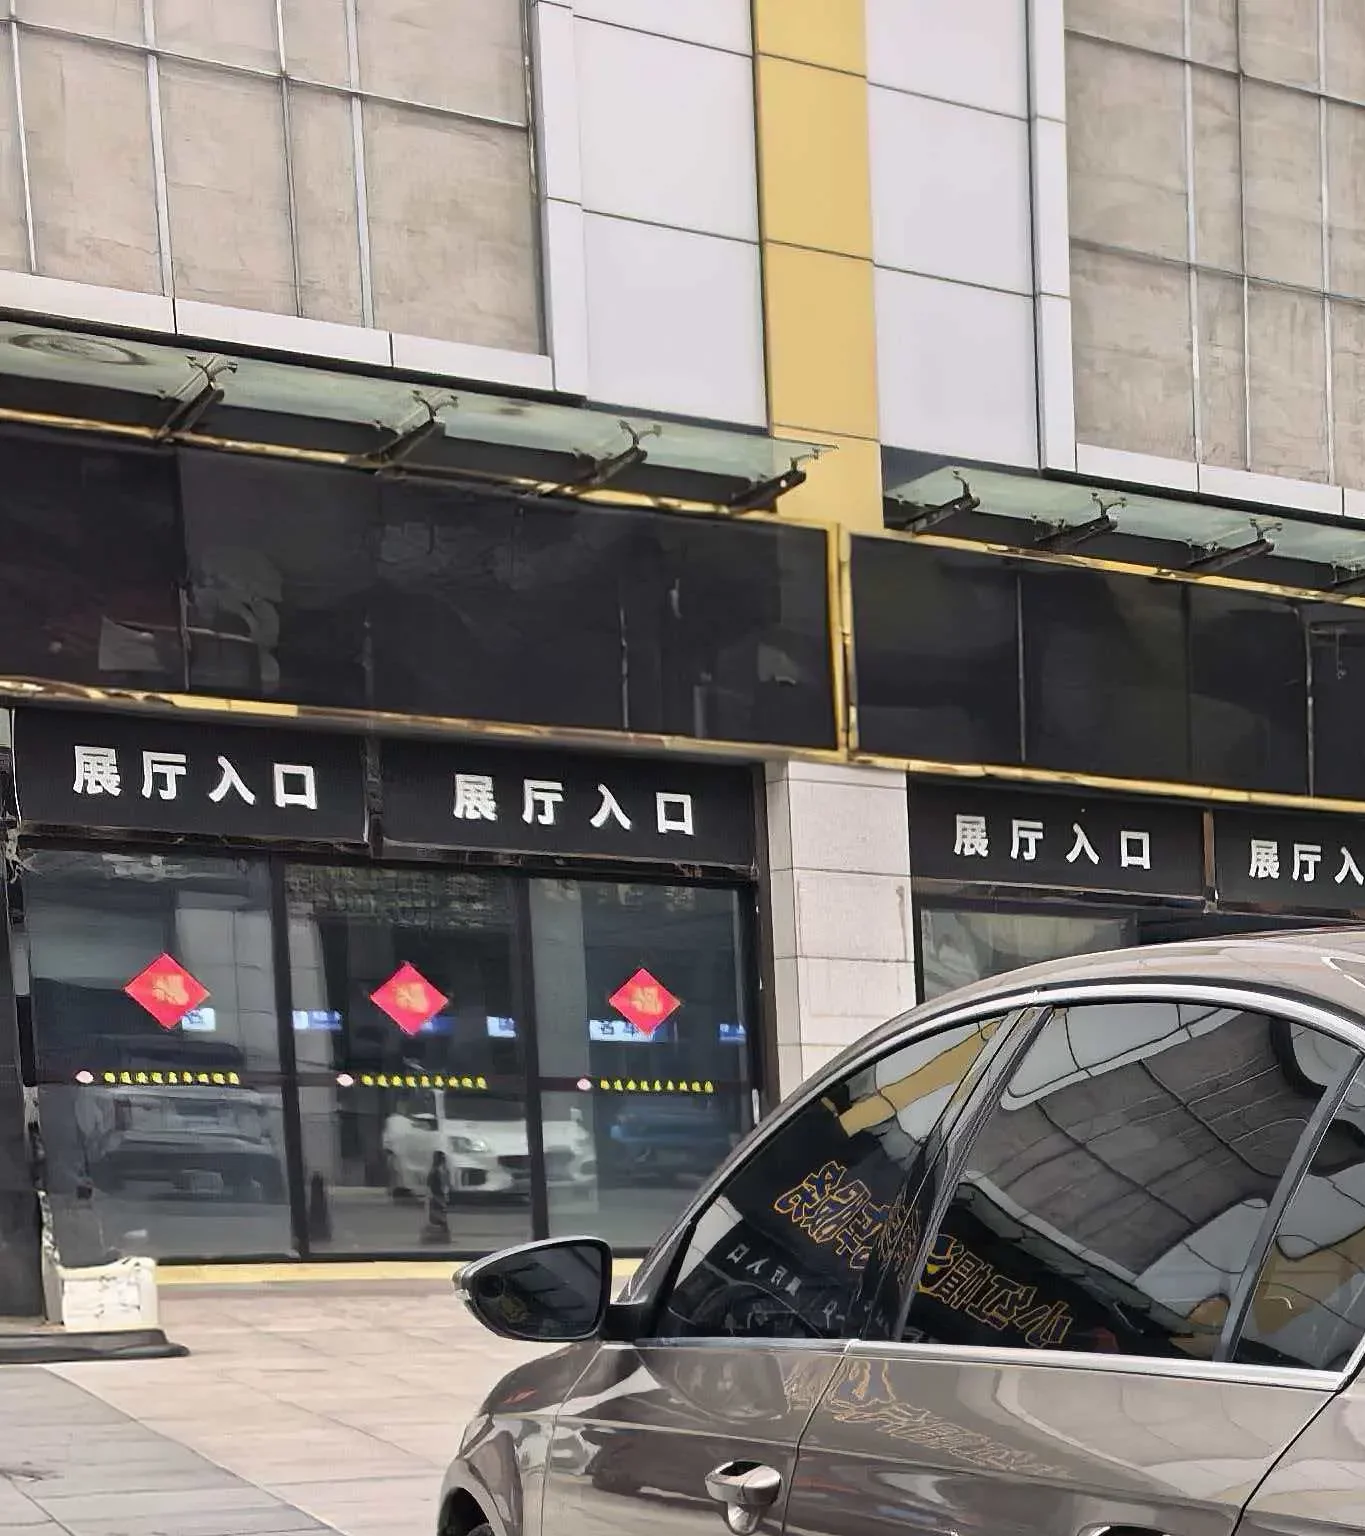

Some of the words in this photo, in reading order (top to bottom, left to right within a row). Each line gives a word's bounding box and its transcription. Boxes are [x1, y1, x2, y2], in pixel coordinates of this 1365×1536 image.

[73, 745, 317, 810] 展厅入口
[453, 773, 695, 836] 展厅入口
[954, 814, 1151, 870] 展厅入口
